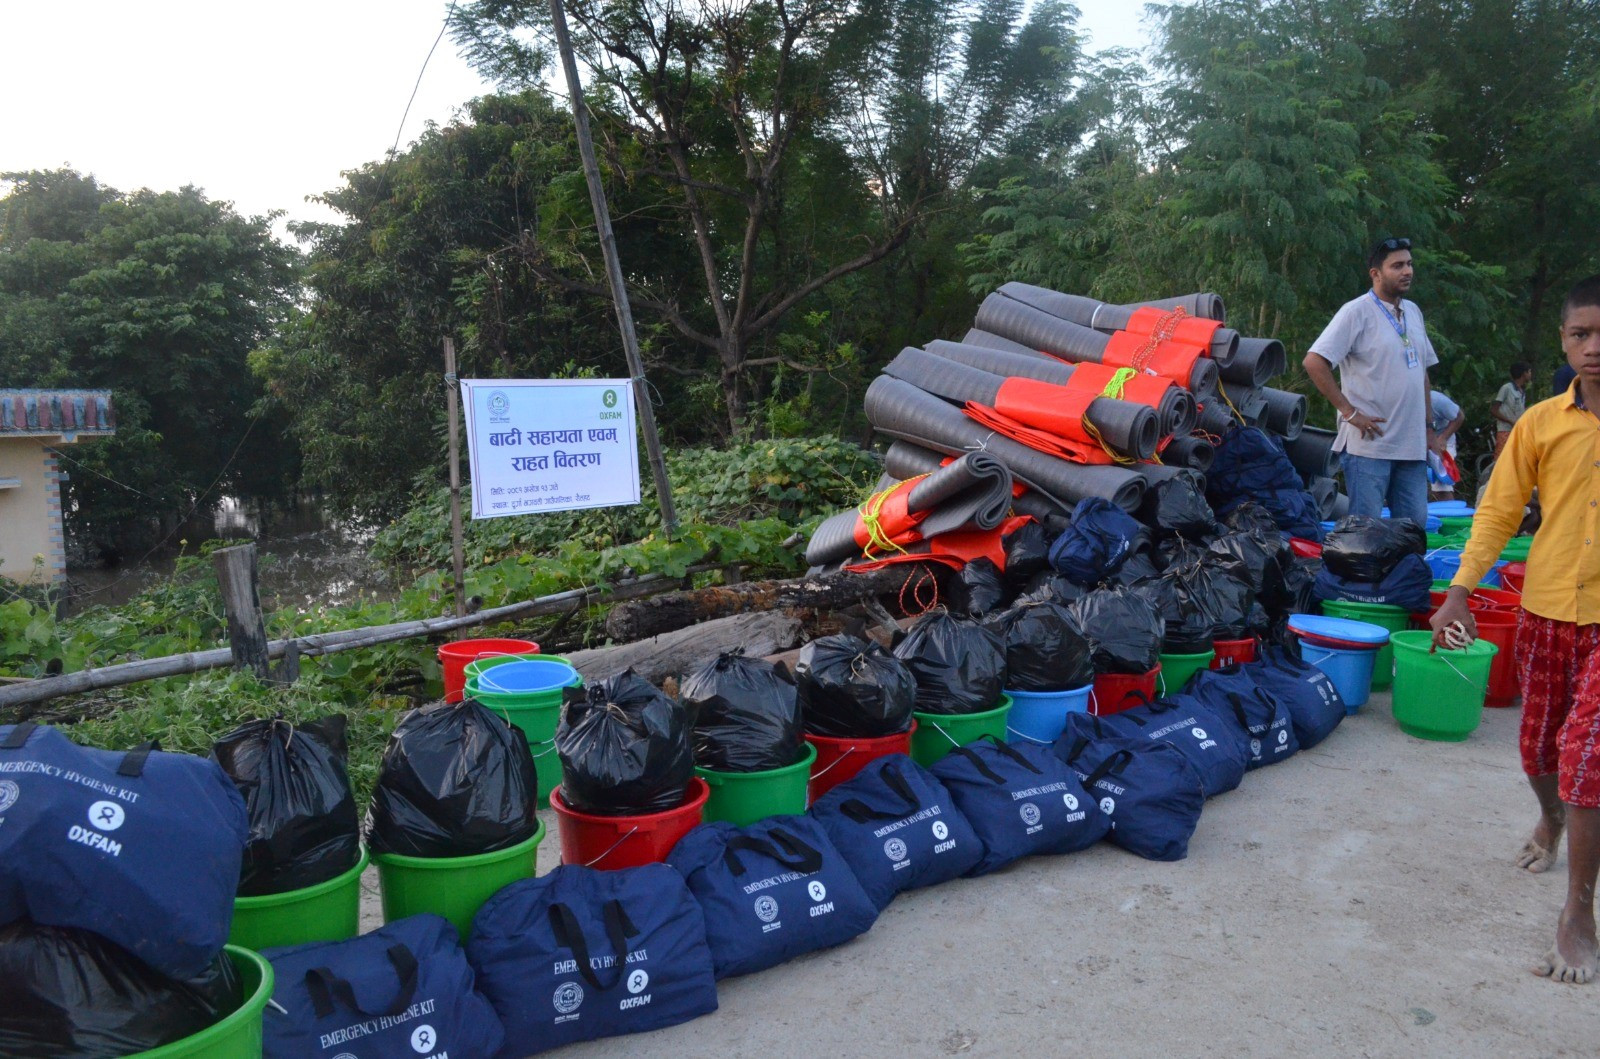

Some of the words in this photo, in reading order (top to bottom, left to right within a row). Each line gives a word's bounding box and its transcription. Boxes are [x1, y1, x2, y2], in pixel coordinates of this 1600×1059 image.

[599, 411, 622, 420] OXFAM
[489, 427, 522, 446] बाढी
[527, 429, 583, 446] सहायता
[587, 428, 618, 443] एवम्
[511, 455, 549, 471] राहत
[553, 450, 601, 468] वितरण
[1199, 739, 1217, 750] OXFAM
[0, 760, 63, 776] MERGENCY
[64, 770, 118, 796] HYGIENE
[118, 788, 140, 803] KIT
[1113, 785, 1125, 796] KIT
[873, 820, 910, 838] EMERGENCY
[907, 808, 934, 824] HYGIENE
[930, 804, 942, 816] KIT
[1066, 810, 1086, 823] OXFAM
[68, 825, 122, 857] OXFAM
[934, 839, 956, 854] OXFAM
[743, 875, 782, 895] EMERGENCY
[809, 901, 834, 917] OXFAM
[634, 949, 648, 962] KIT
[620, 994, 651, 1010] OXFAM
[320, 1019, 380, 1049] EMERGENCY
[420, 999, 435, 1015] KIT
